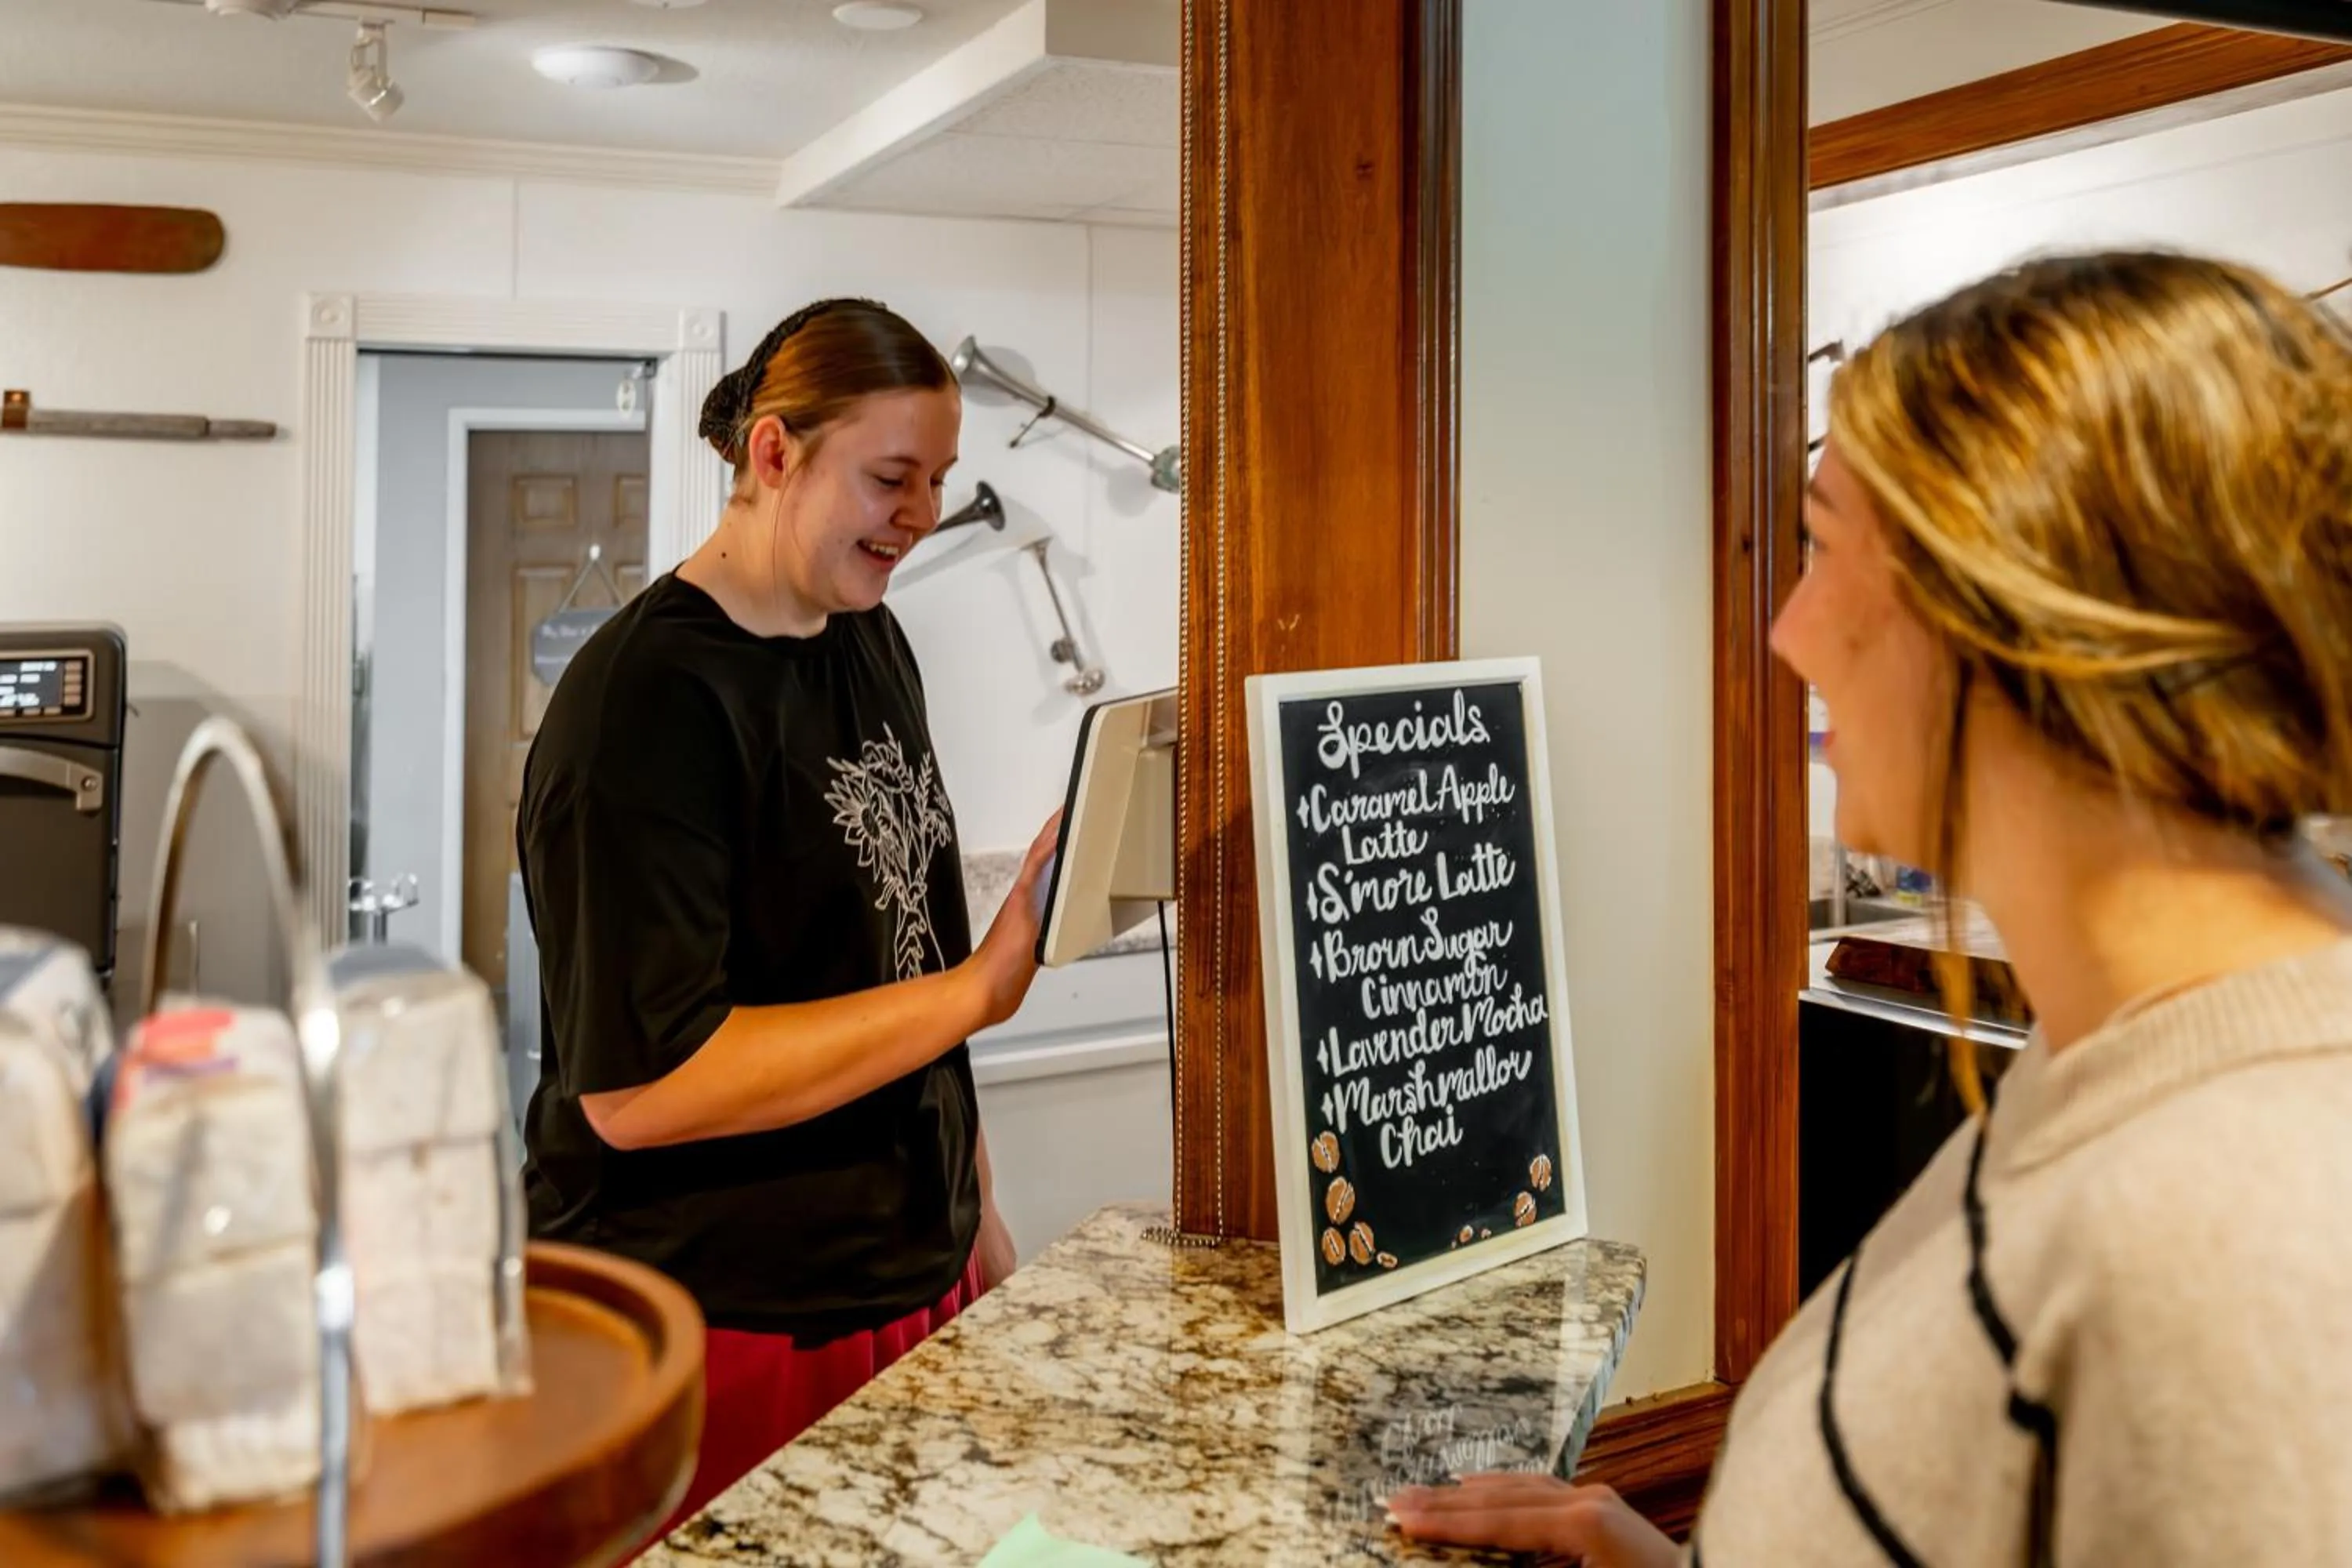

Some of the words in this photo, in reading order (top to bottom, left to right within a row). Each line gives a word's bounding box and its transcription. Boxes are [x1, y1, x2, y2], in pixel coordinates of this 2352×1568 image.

[1317, 688, 1490, 779] Specials
[1310, 768, 1438, 833] Caramel
[1436, 762, 1515, 824] Apple
[1341, 820, 1428, 865] Latte
[1317, 862, 1432, 924] S'more
[1436, 842, 1515, 900] Latte
[1323, 929, 1425, 983] Brown
[1420, 906, 1513, 978] Sugar
[1329, 1007, 1463, 1077] Lavender
[1461, 982, 1548, 1043] Mocha
[1361, 963, 1508, 1019] Cinnamon
[1334, 1044, 1533, 1134] Marshmallow
[1380, 1103, 1463, 1169] Chai
